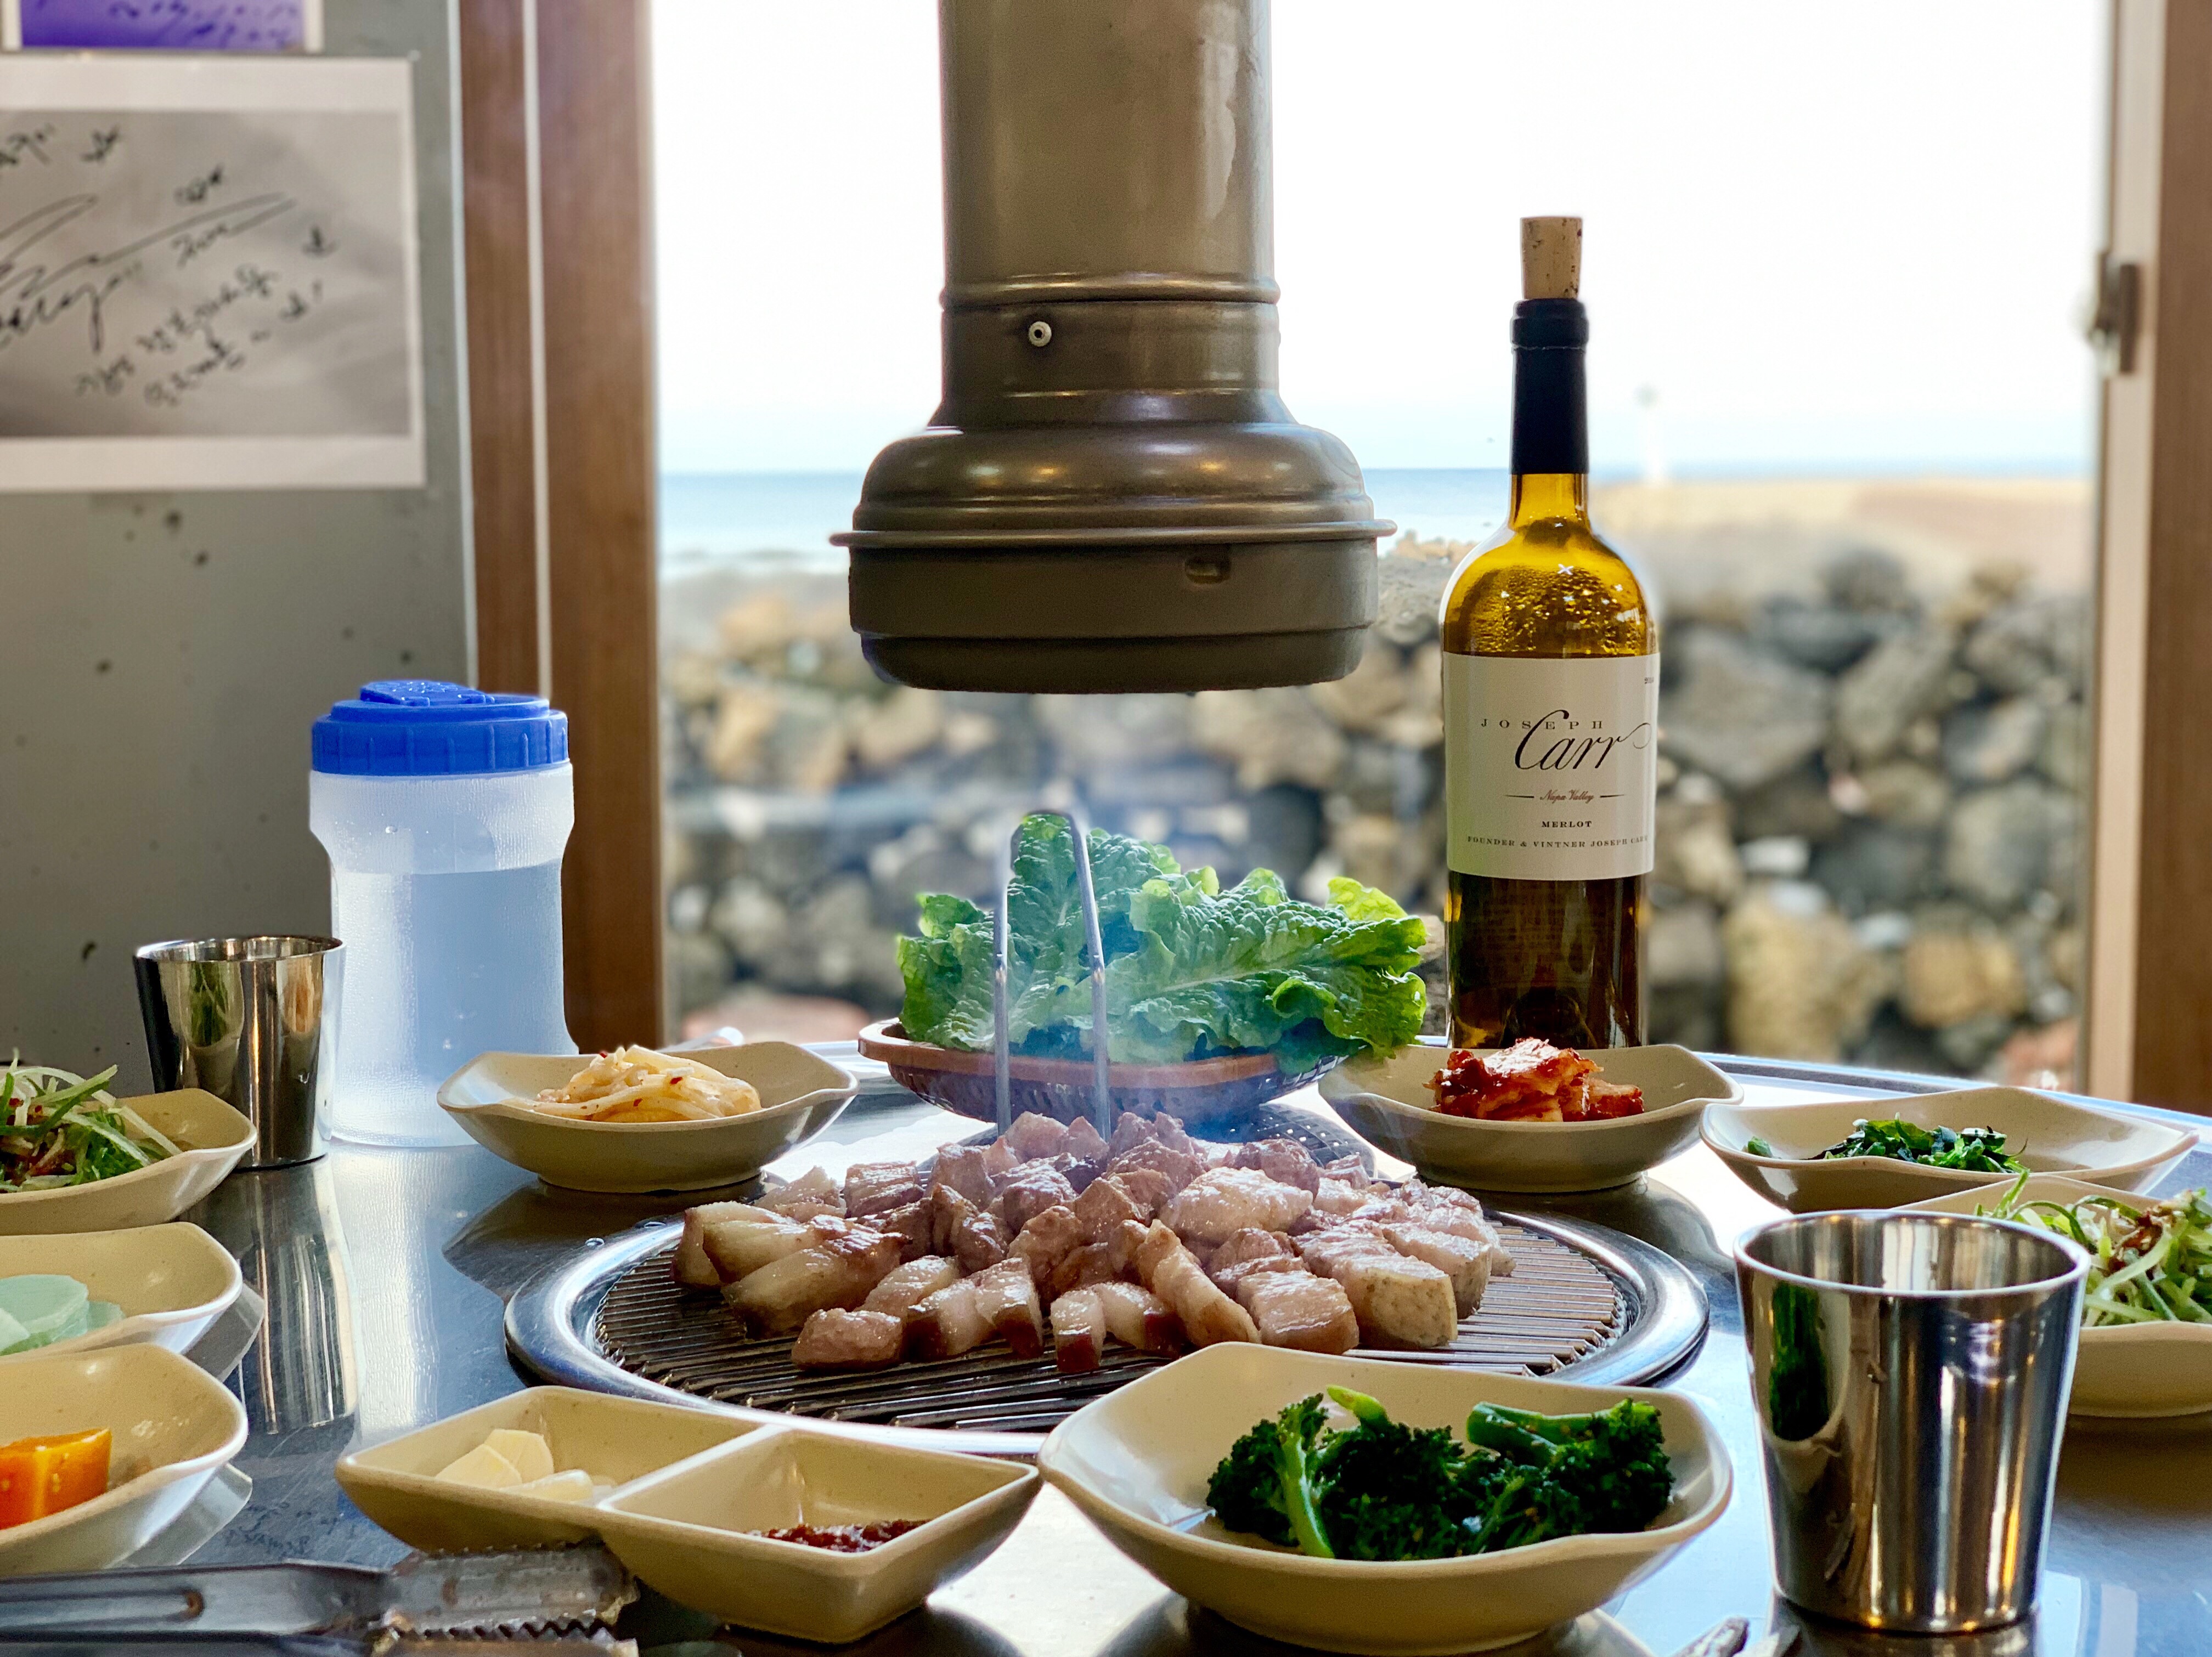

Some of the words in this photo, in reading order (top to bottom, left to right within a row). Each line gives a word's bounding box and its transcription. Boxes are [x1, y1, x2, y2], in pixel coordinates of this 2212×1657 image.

[1481, 718, 1603, 730] JOSEPH
[1515, 709, 1651, 770] Carr
[1539, 789, 1567, 804] Napa
[1568, 789, 1594, 804] Valley
[1468, 836, 1515, 846] FOUNDER
[1590, 839, 1628, 847] JOSEPH
